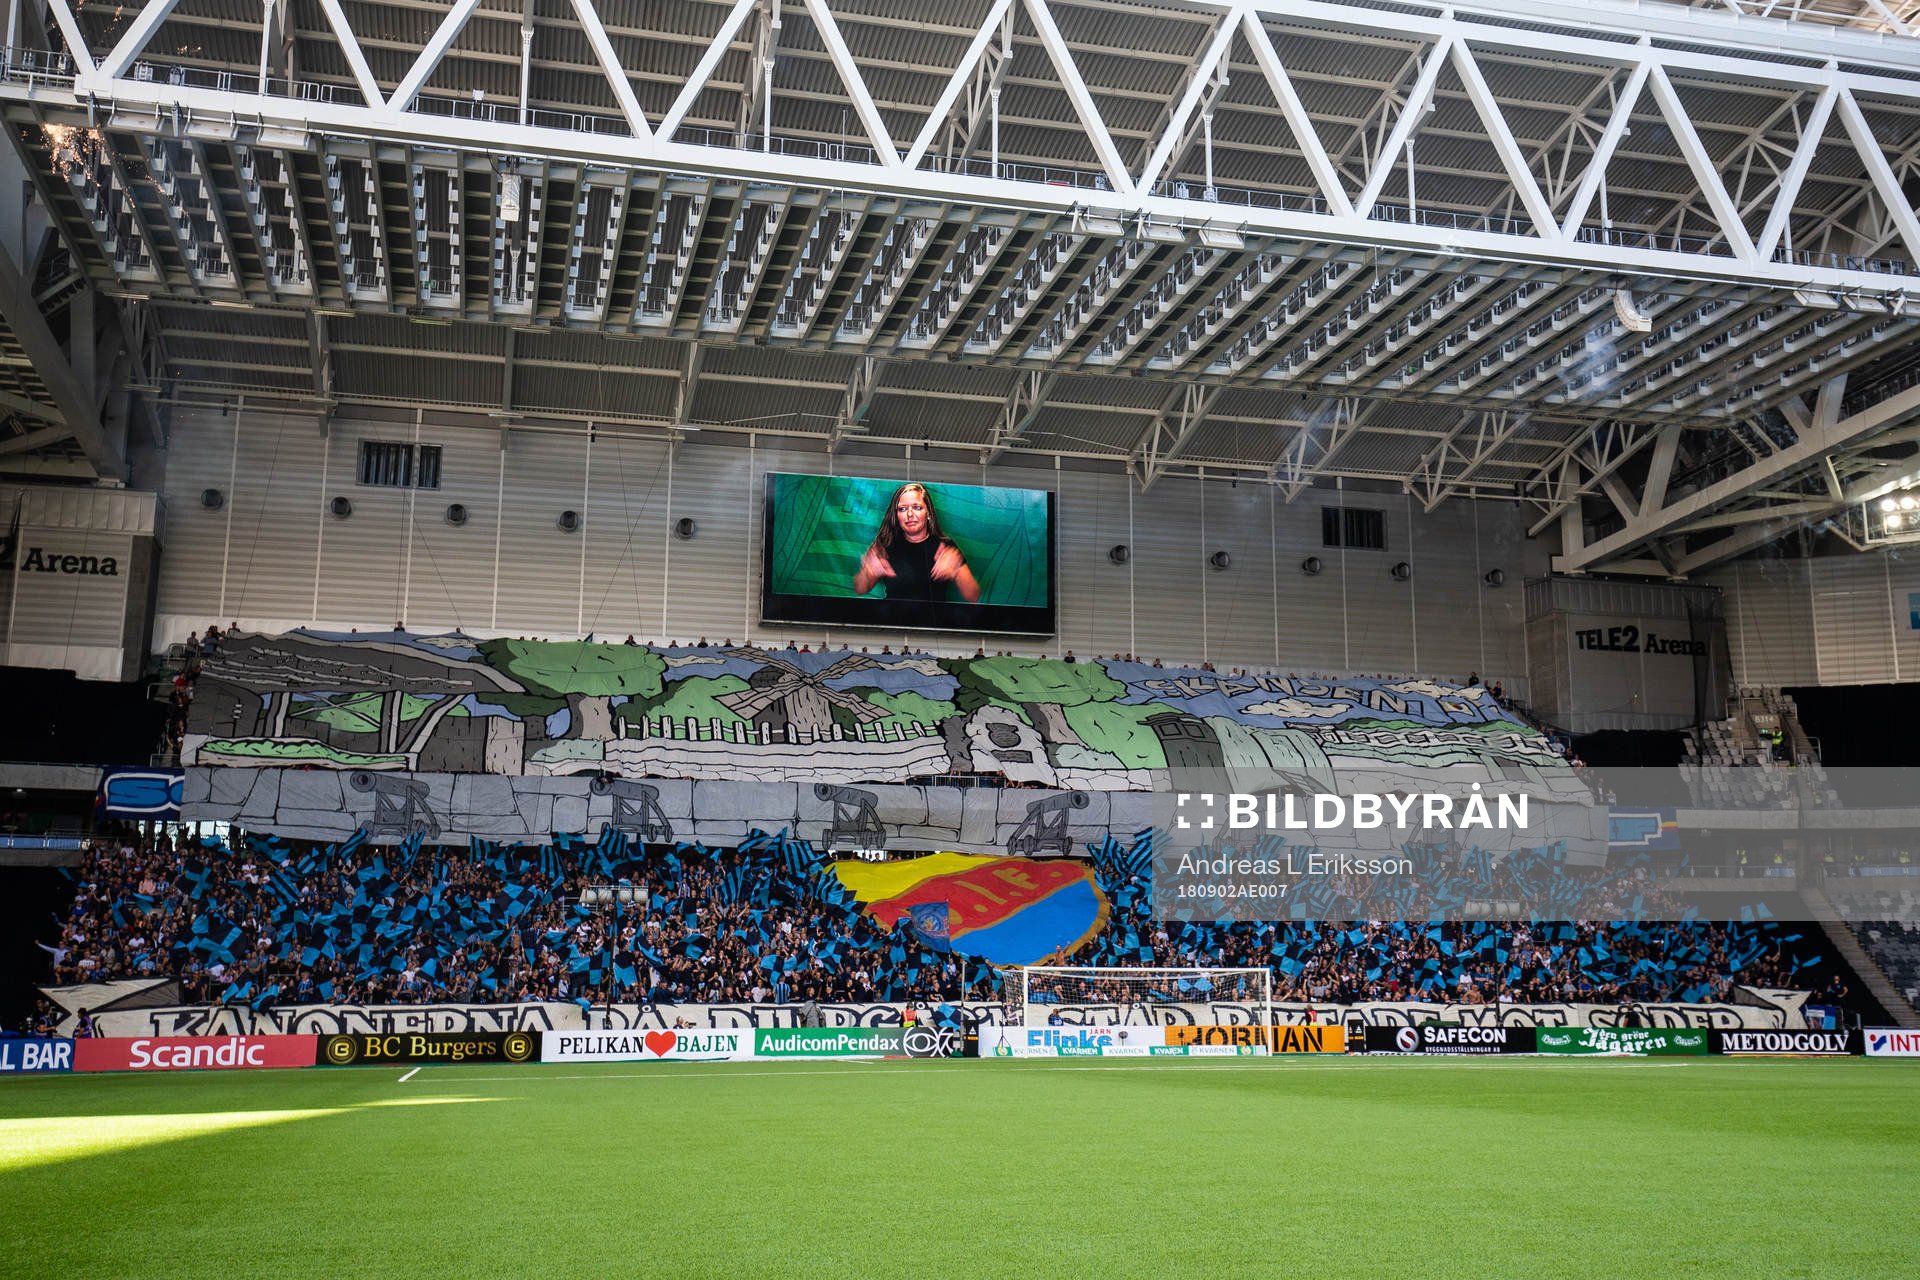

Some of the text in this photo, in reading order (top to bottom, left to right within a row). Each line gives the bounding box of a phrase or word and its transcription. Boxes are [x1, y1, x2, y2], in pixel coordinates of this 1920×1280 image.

[21, 547, 118, 576] Arena
[1575, 625, 1706, 656] TELE2 Arena
[129, 1037, 265, 1068] Scandic
[364, 1036, 497, 1060] BC Burgers
[558, 1035, 739, 1055] PELIKAN BAJEN
[761, 1034, 900, 1051] AudicomPendax
[1199, 1047, 1236, 1055] KVARNEN
[1722, 1033, 1848, 1051] METODGOLV
[22, 1042, 71, 1070] BAR
